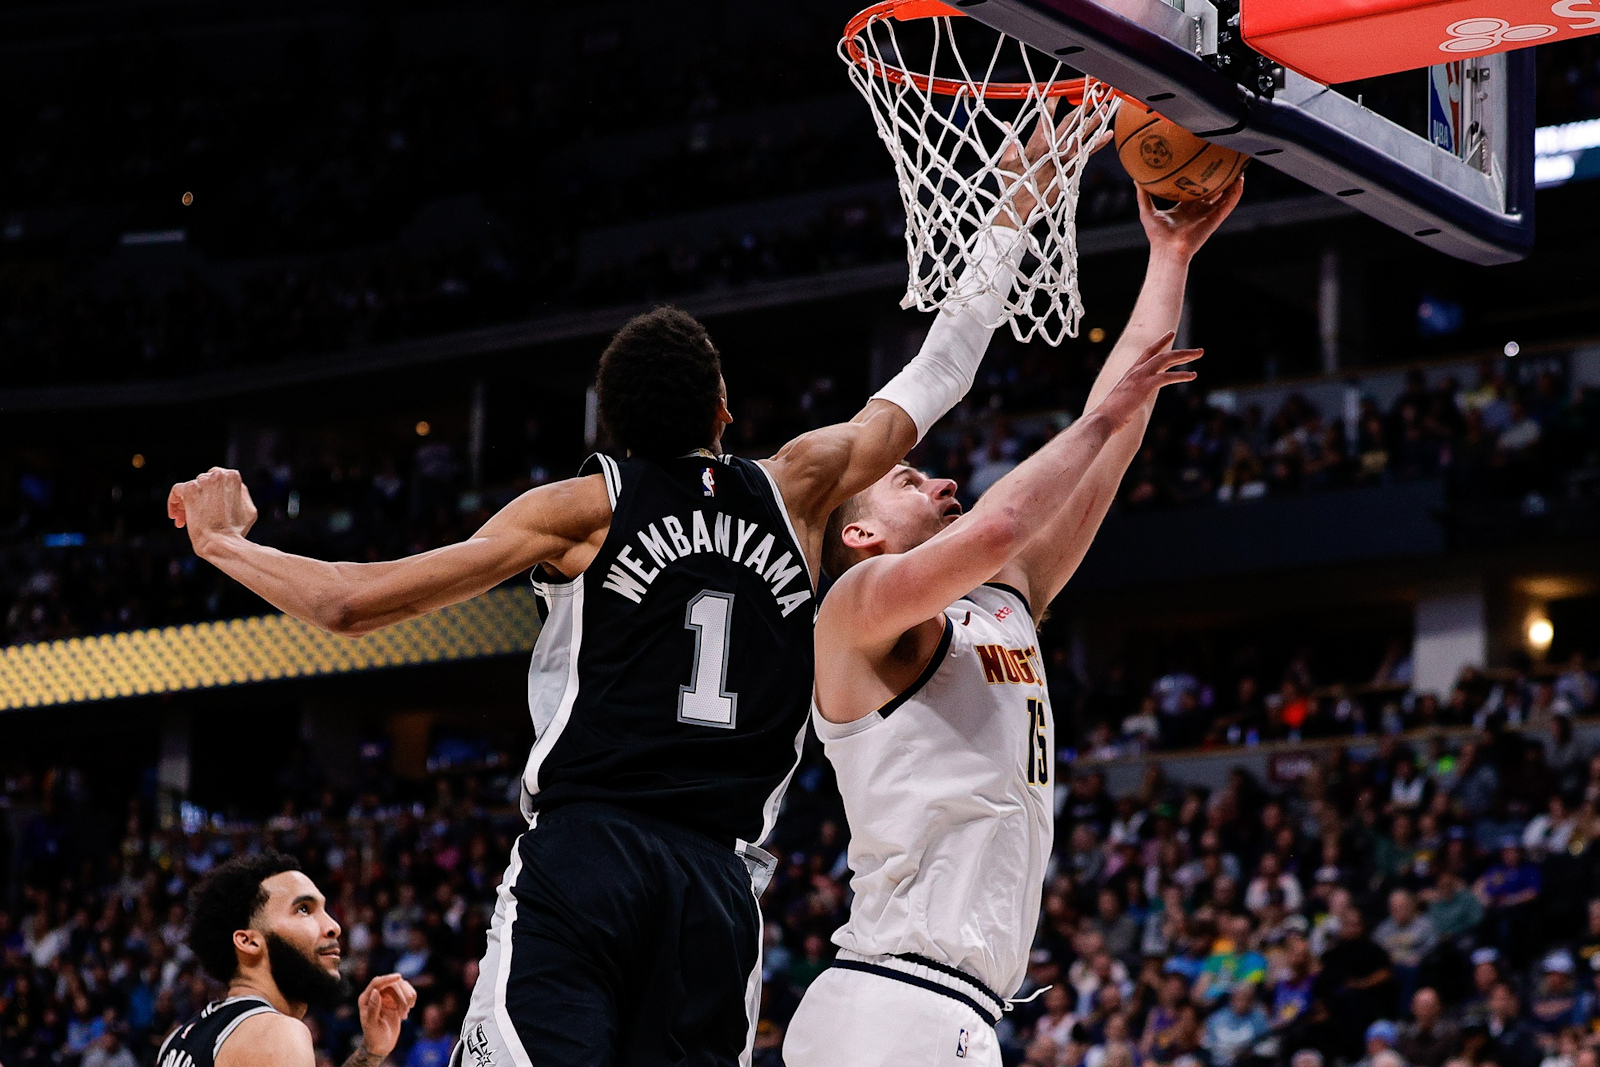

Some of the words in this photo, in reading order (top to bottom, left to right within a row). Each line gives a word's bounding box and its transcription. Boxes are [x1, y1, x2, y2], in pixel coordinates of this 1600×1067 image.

[1551, 0, 1600, 30] S
[602, 509, 812, 618] WEMBANYAMA
[676, 588, 738, 729] 1
[1026, 696, 1049, 787] 15
